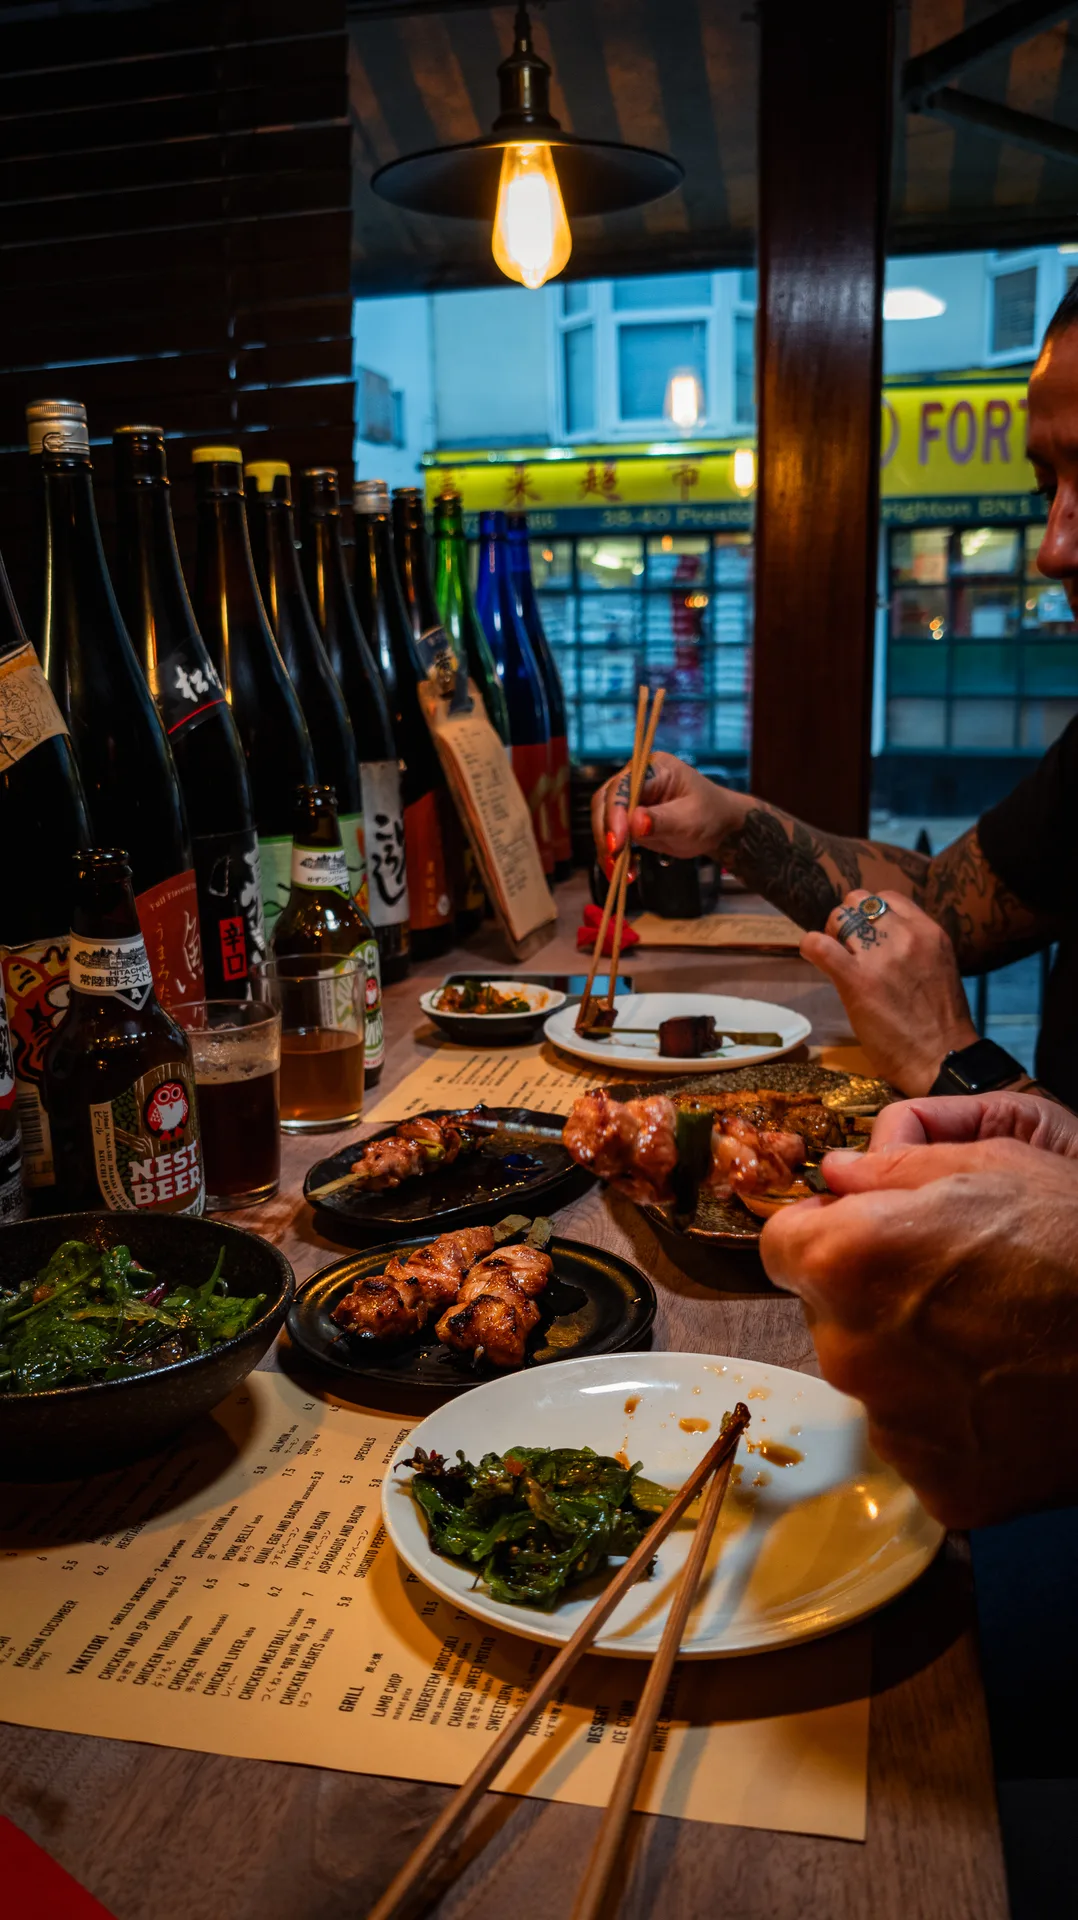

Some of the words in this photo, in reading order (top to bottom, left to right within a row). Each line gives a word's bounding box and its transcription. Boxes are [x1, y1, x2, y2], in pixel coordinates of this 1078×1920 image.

[881, 501, 972, 522] righton
[150, 894, 167, 911] Full
[224, 922, 245, 975] 辛口
[130, 988, 142, 1000] A
[128, 1140, 199, 1182] NEST
[131, 1165, 201, 1206] BEER
[269, 1433, 292, 1453] SALMON
[353, 1437, 377, 1461] SPECIALS
[368, 1479, 383, 1488] 5.8
[192, 1532, 219, 1559] CHICKEN
[211, 1516, 230, 1531] SKIN
[253, 1466, 268, 1474] 5.8
[222, 1544, 243, 1561] PORK
[234, 1524, 256, 1543] BELLY
[282, 1468, 296, 1476] 7.5
[253, 1545, 274, 1564] QUAIL
[266, 1533, 283, 1545] EGG
[276, 1520, 291, 1532] AND
[284, 1500, 305, 1519] BACON
[310, 1470, 325, 1480] 5.8
[284, 1544, 309, 1569] TOMATO
[302, 1530, 318, 1543] AND
[310, 1510, 331, 1530] BACON
[339, 1474, 354, 1484] 5.5
[339, 1525, 354, 1537] AND
[346, 1504, 367, 1524] BACON
[61, 1560, 79, 1571] 5.5
[93, 1564, 110, 1577] 6.2
[317, 1537, 347, 1574] ASPARAGUS
[353, 1549, 379, 1578] SHISHITO
[66, 1635, 109, 1674] YAKITORI
[111, 1602, 135, 1626] GRILLED
[130, 1577, 156, 1602] SKEWERS
[168, 1539, 186, 1558] portion
[13, 1638, 47, 1668] KOREAN
[39, 1600, 79, 1637] CUCUMBER
[98, 1648, 131, 1680] CHICKEN
[124, 1632, 143, 1647] AND
[136, 1621, 151, 1631] SP
[144, 1599, 169, 1621] ONION
[171, 1576, 187, 1586] 6.5
[133, 1653, 165, 1686] CHICKEN
[156, 1630, 182, 1651] THIGH
[202, 1579, 218, 1589] 6.5
[202, 1661, 234, 1696] CHICKEN
[224, 1639, 248, 1660] LIVER
[267, 1586, 283, 1597] 6.2
[168, 1657, 199, 1691] CHICKEN
[190, 1637, 213, 1656] WING
[208, 1613, 229, 1636] tebasaki
[238, 1665, 268, 1700] CHICKEN
[259, 1629, 292, 1664] MEATBALL
[279, 1670, 309, 1705] CHICKEN
[299, 1643, 325, 1669] HEARTS
[336, 1596, 353, 1607] 5.8
[280, 1657, 296, 1669] egg
[288, 1643, 302, 1656] yolk
[295, 1633, 310, 1642] dip
[371, 1694, 394, 1718] LAMB
[384, 1673, 404, 1694] CHOP
[421, 1601, 440, 1616] 10.5
[409, 1673, 444, 1721] TENDERSTEM
[433, 1635, 460, 1671] BROCCOLI
[447, 1691, 473, 1727] CHARRED
[463, 1665, 484, 1690] SWEET
[474, 1637, 496, 1664] POTATO
[338, 1686, 365, 1712] GRILL
[392, 1701, 407, 1720] market
[402, 1688, 413, 1705] price
[485, 1684, 517, 1731] SWEETCORN
[586, 1705, 611, 1744] DESSERT
[612, 1729, 628, 1744] ICE
[650, 1725, 669, 1752] WHITE
